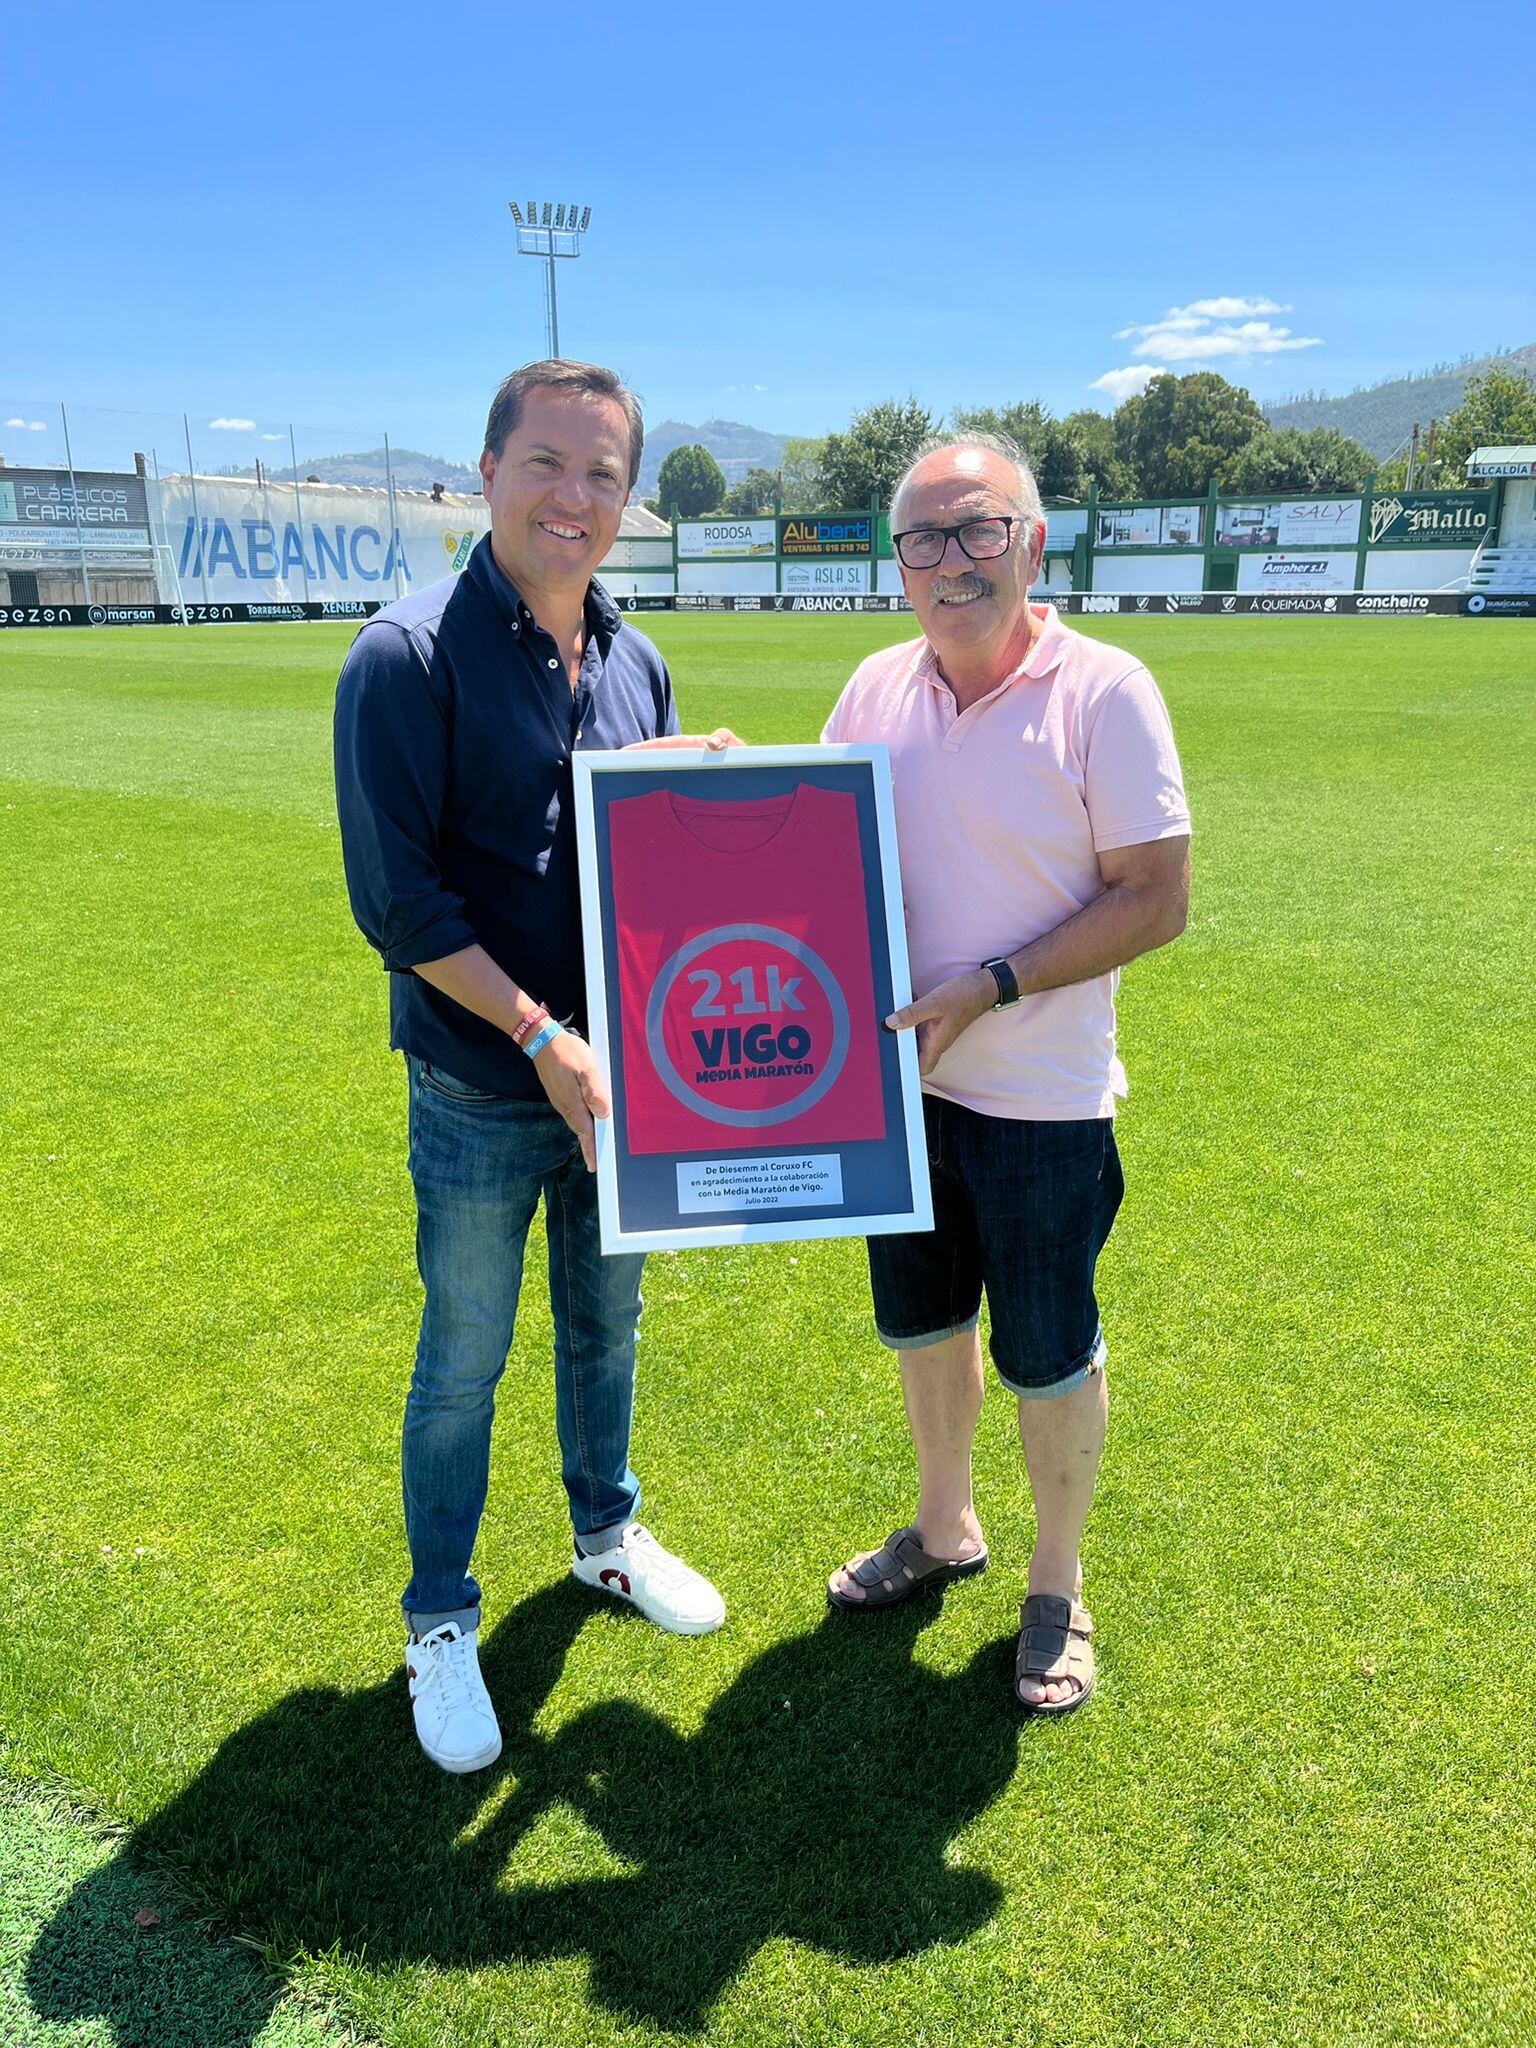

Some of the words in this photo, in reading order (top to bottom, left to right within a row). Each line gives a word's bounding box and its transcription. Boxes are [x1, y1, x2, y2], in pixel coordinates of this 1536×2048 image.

[25, 505, 128, 521] CARRERA
[1286, 503, 1354, 524] SALY
[1403, 508, 1487, 531] Mallo
[704, 526, 752, 540] RODOSA
[783, 520, 870, 541] Aluberti
[782, 544, 822, 553] VENTANAS
[815, 567, 844, 583] ASLA
[848, 567, 861, 583] SL
[321, 601, 367, 614] XENERA
[1262, 599, 1323, 612] QUEIMADA
[1356, 595, 1429, 608] concheiro
[107, 609, 156, 620] marsan
[687, 964, 807, 1018] 21k
[690, 1023, 811, 1069] VIGO
[705, 1166, 717, 1175] De
[719, 1164, 759, 1174] Diesemm
[760, 1163, 769, 1172] al
[770, 1162, 801, 1171] Coruxo
[802, 1161, 813, 1169] FC
[702, 1175, 763, 1188] agradecimiento
[770, 1173, 779, 1182] la
[780, 1171, 829, 1181] colaboración
[714, 1189, 722, 1197] la
[723, 1187, 749, 1196] Media
[751, 1184, 787, 1194] Maratón
[789, 1184, 800, 1192] de
[801, 1183, 823, 1193] Vigo.
[744, 1197, 762, 1205] Julio
